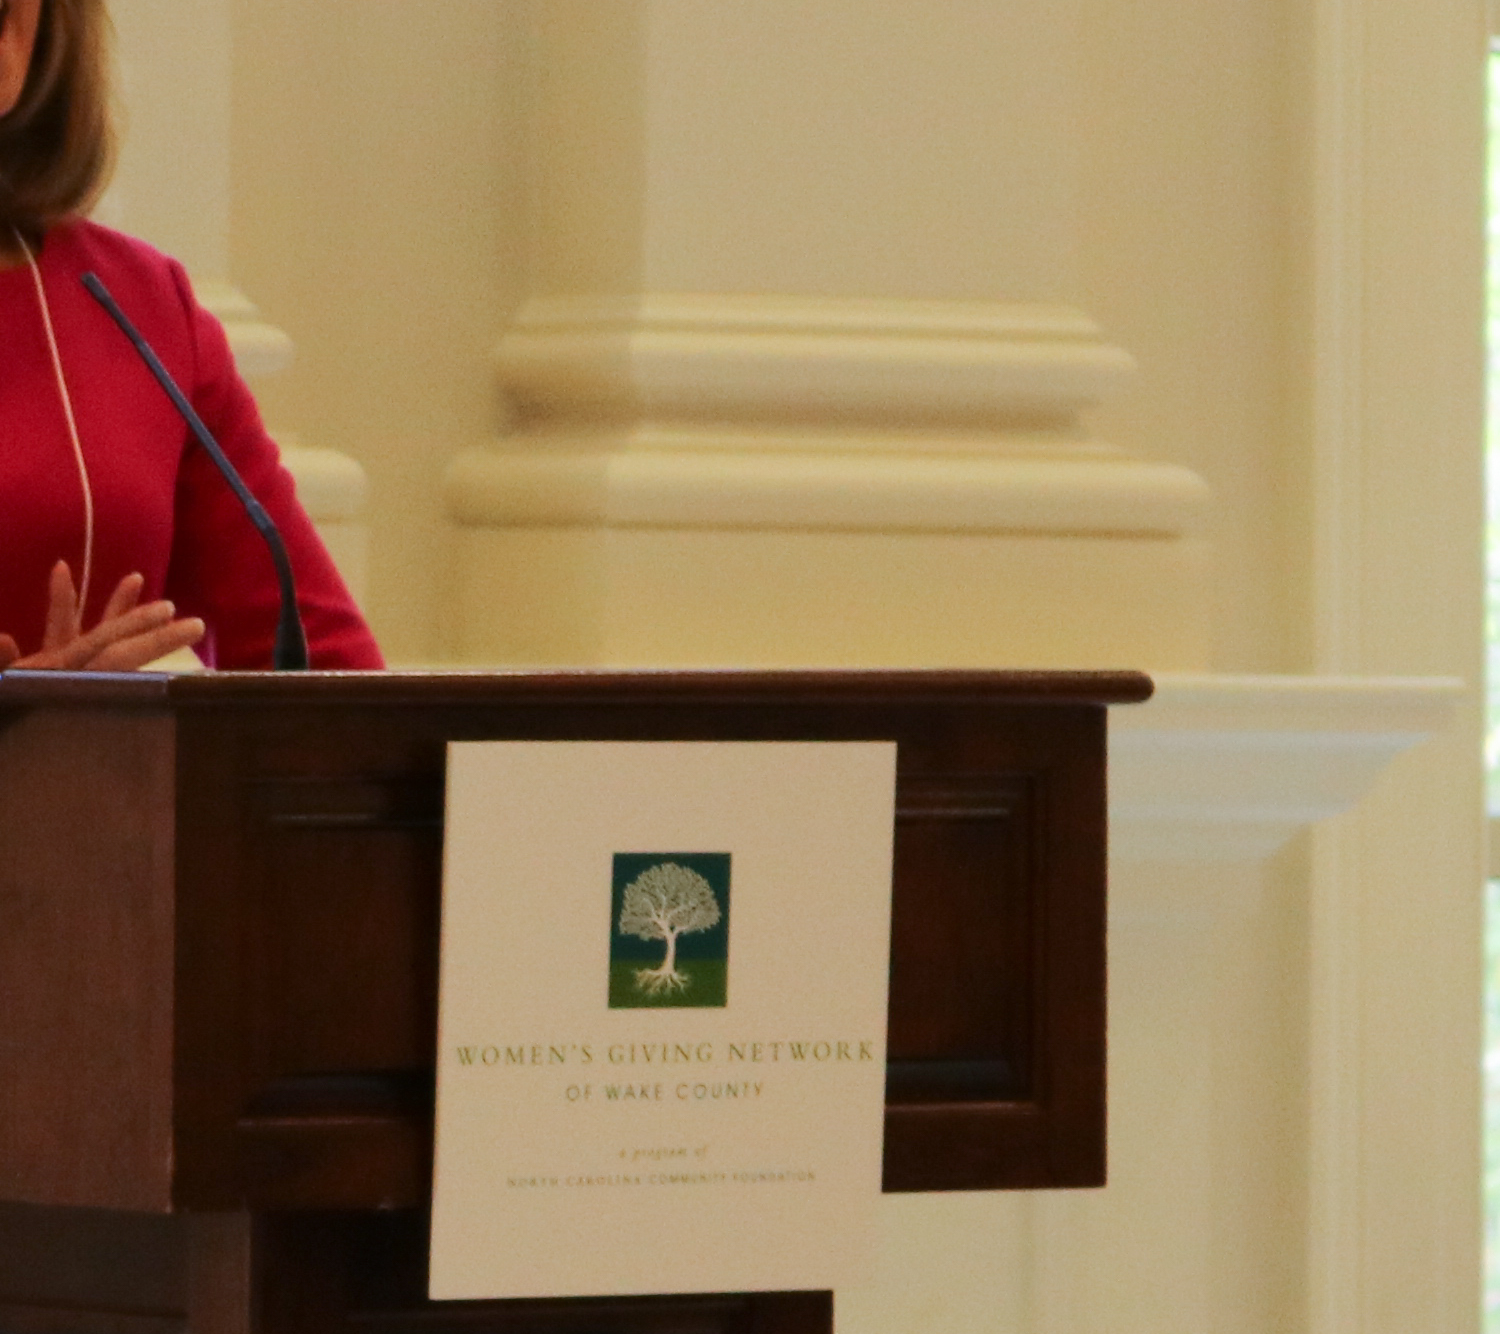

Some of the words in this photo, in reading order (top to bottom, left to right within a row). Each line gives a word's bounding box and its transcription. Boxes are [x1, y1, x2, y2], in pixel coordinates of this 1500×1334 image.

[456, 1044, 594, 1066] WOMEN'S
[607, 1042, 713, 1064] GIVING
[728, 1040, 876, 1063] NETWORK
[565, 1083, 593, 1102] OF
[605, 1082, 664, 1101] WAKE
[675, 1080, 765, 1100] COUNTY
